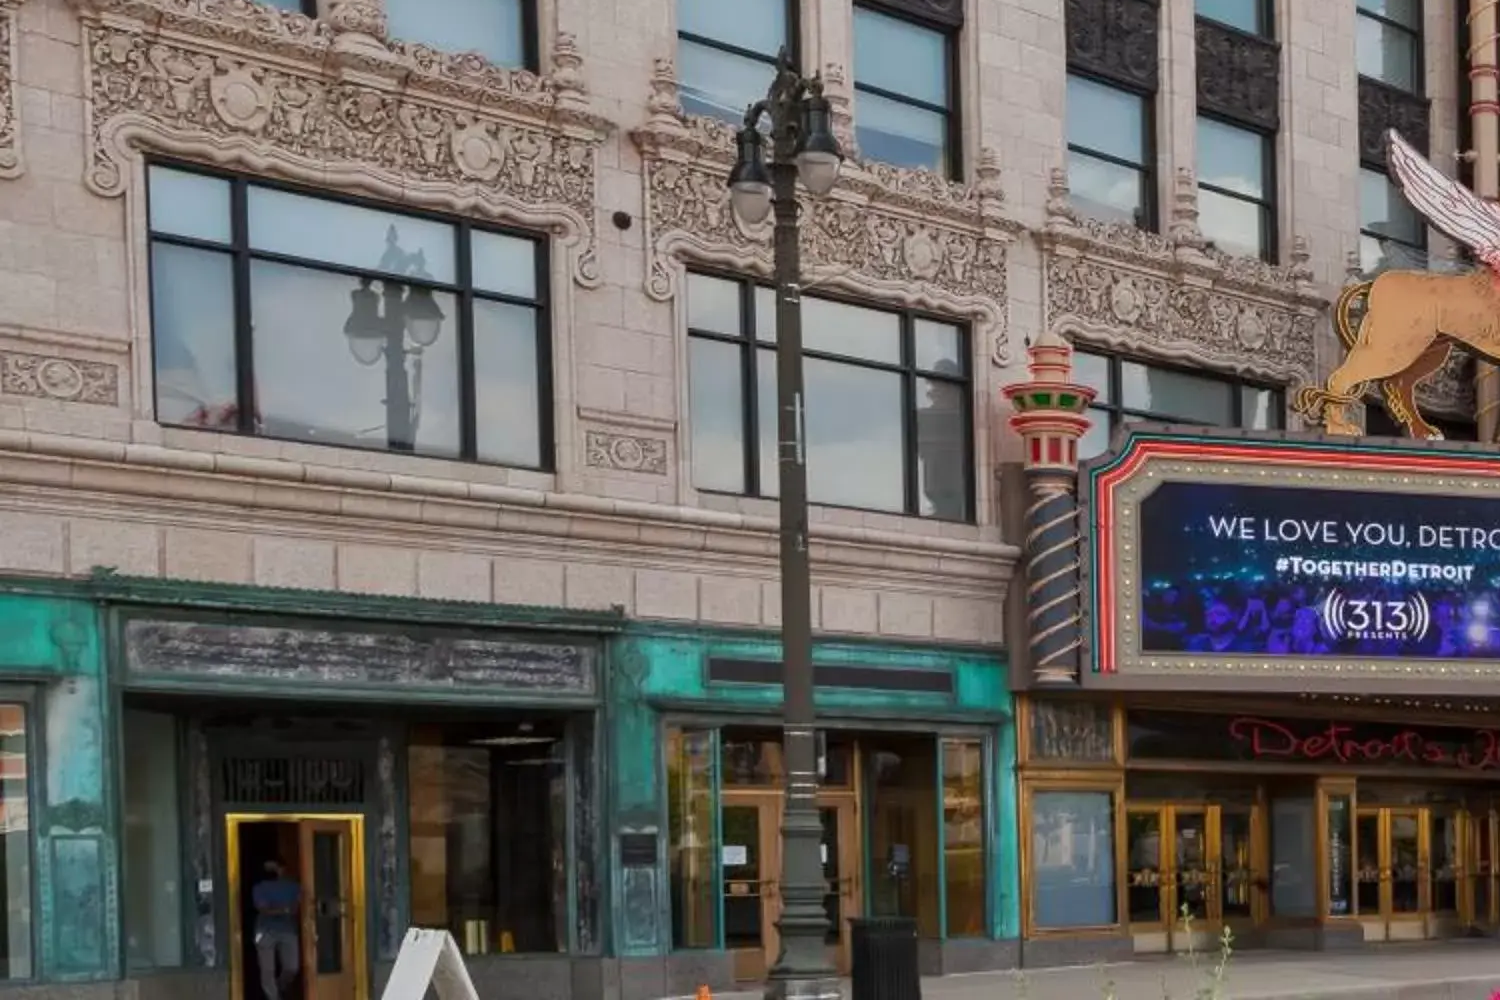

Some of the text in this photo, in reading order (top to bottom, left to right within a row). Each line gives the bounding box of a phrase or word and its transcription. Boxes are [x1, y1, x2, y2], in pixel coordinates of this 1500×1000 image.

[1208, 515, 1256, 540] WE
[1264, 519, 1338, 544] LOVE
[1346, 630, 1408, 641] PRESENTS
